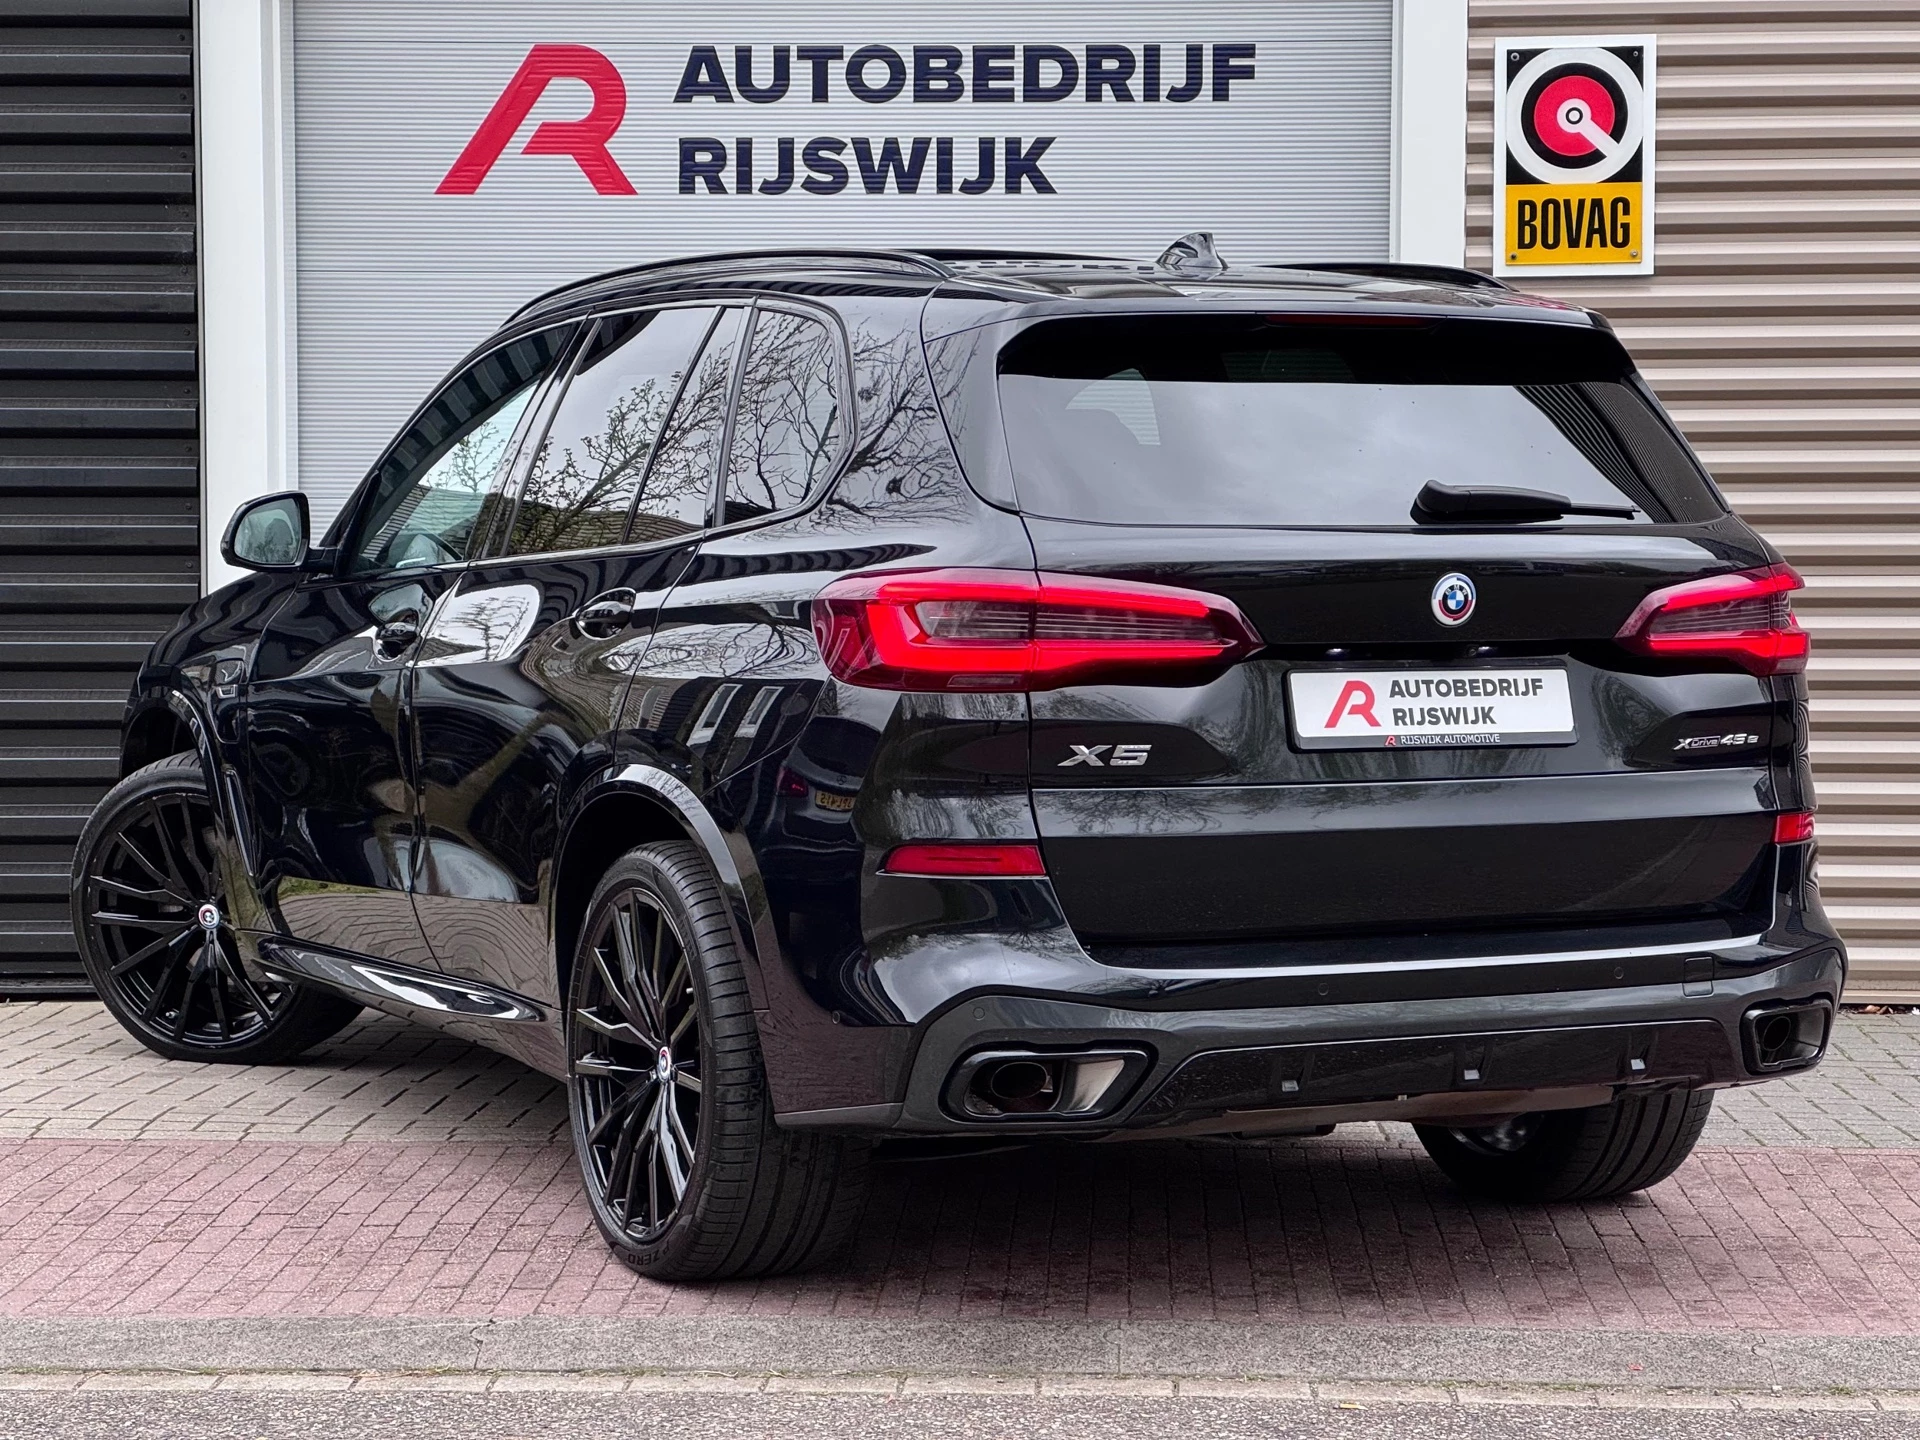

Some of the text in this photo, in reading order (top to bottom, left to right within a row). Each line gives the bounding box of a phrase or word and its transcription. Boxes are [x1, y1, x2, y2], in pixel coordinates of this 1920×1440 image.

[672, 43, 1257, 104] AUTOBEDRIJF
[677, 136, 1058, 196] RIJSWIJK
[1517, 196, 1631, 250] BOVAG
[1389, 678, 1544, 699] AUTOBEDRIJF
[1392, 706, 1497, 726] RIJSWIJK
[1400, 735, 1442, 745] RIJSWIJK
[1443, 733, 1501, 744] AUTOMOTIVE
[1057, 744, 1153, 767] X5
